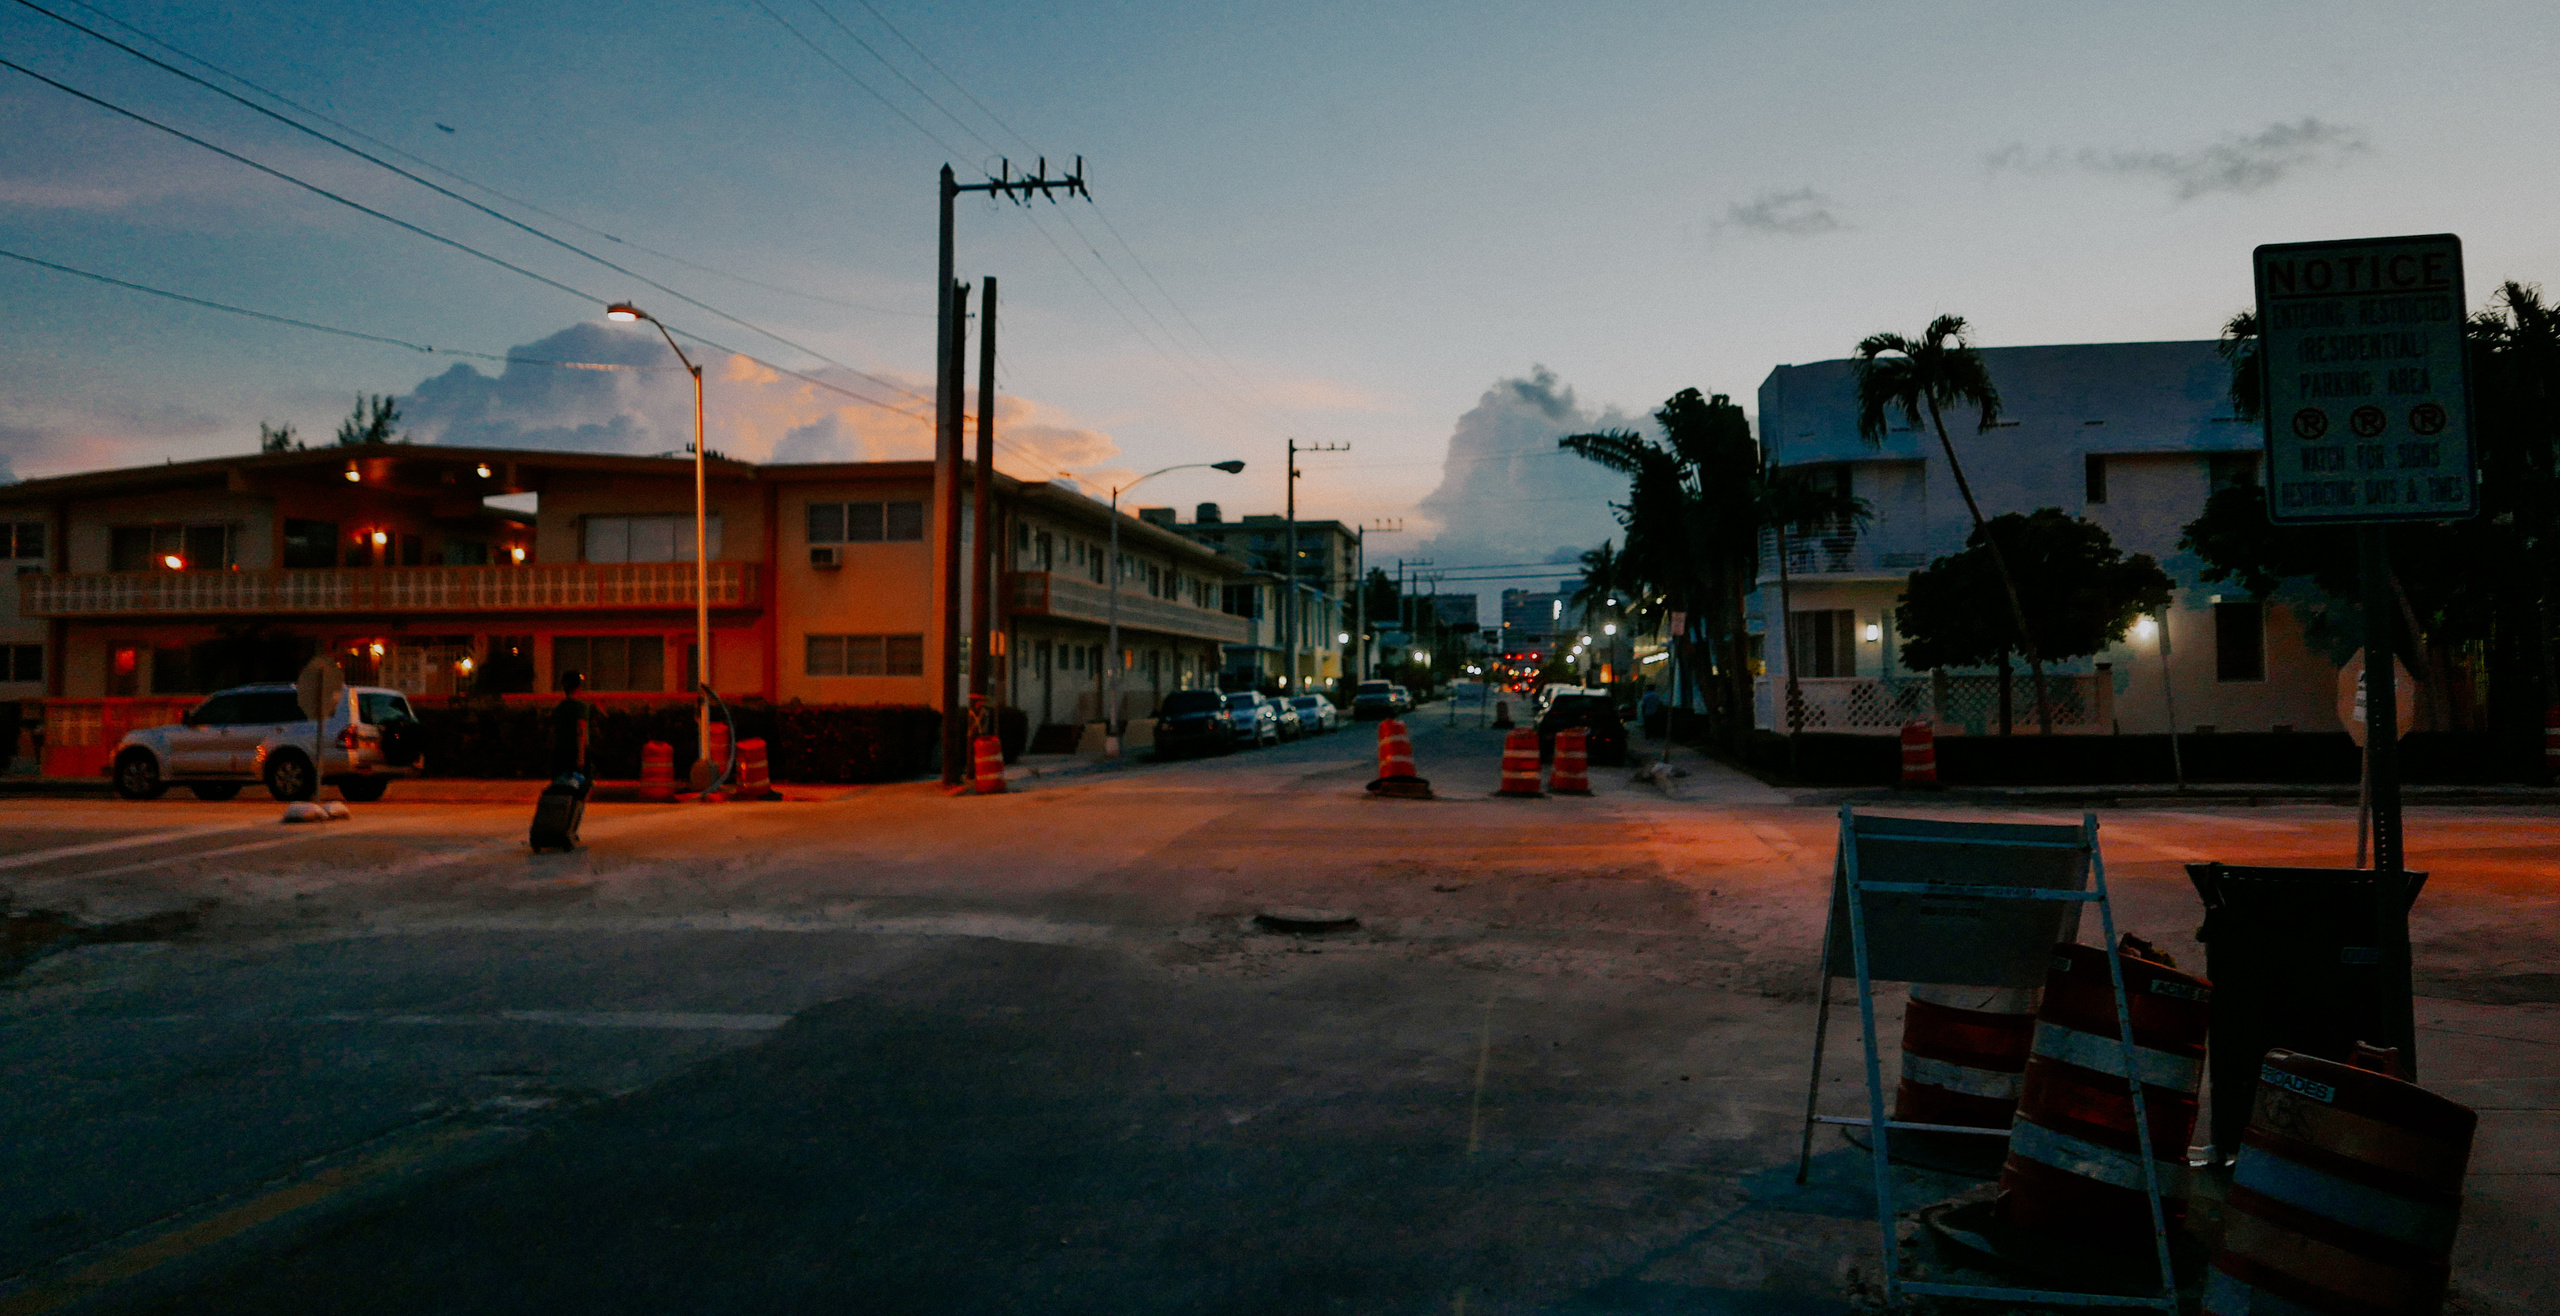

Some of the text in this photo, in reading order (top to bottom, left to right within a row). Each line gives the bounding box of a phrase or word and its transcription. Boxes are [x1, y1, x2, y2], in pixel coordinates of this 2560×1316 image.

[2266, 251, 2451, 294] NOTICE
[2270, 295, 2451, 330] ENTERING RESTRICTED
[2300, 367, 2431, 399] PARKING AREA
[2300, 442, 2440, 472] WATCH FOR SIGNS
[2281, 476, 2464, 507] RESTRICTING DAYS & TIMES
